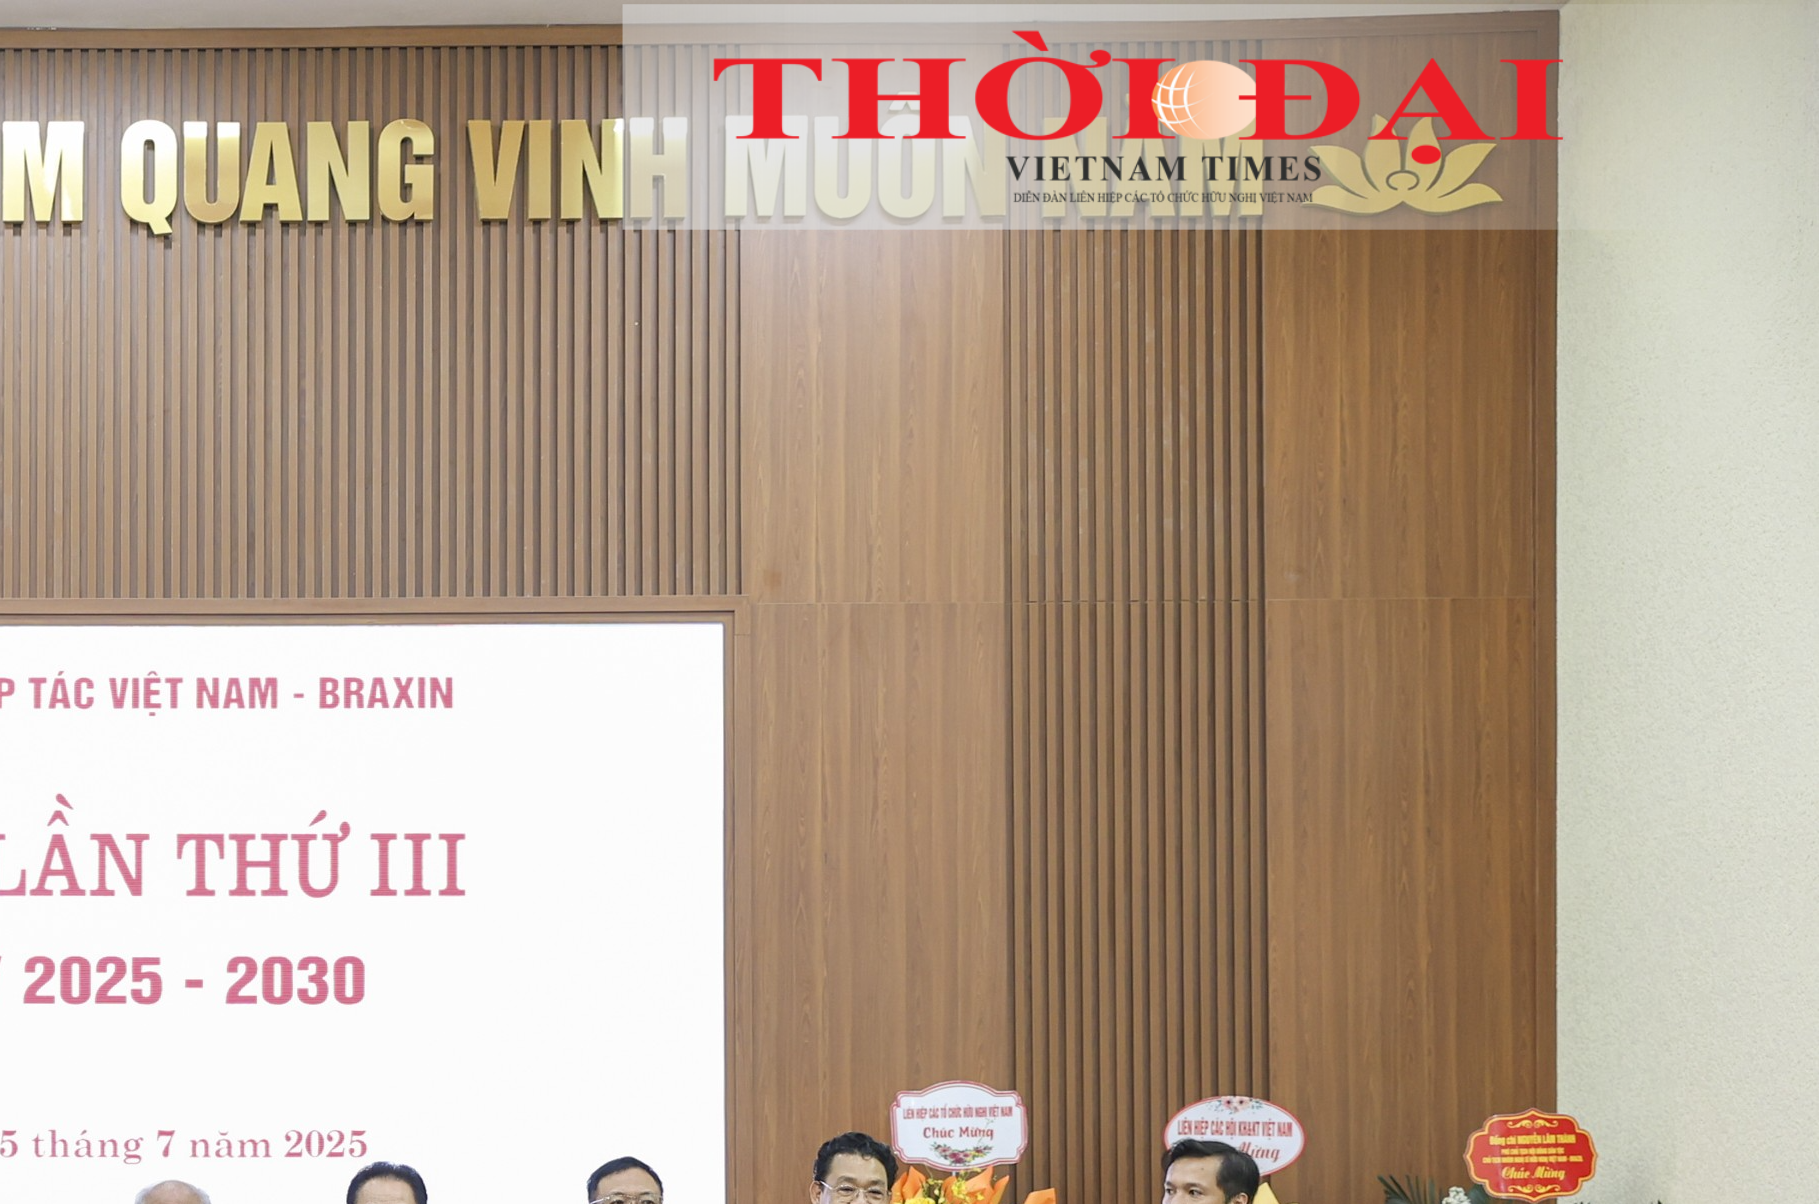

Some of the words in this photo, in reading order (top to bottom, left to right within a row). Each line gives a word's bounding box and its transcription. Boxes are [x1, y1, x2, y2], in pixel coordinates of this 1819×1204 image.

[120, 119, 435, 236] QUANG
[467, 117, 688, 222] VINH
[28, 671, 95, 710] TÁC
[108, 671, 184, 716] VIỆT
[196, 677, 279, 709] NAM
[318, 676, 454, 710] BRAXIN
[176, 810, 351, 898] THỨ
[370, 833, 466, 897] III
[24, 955, 163, 1005] 2025
[185, 979, 203, 988] -
[226, 955, 366, 1005] 2030
[32, 1129, 144, 1167] tháng
[157, 1129, 176, 1158] 7
[189, 1132, 272, 1158] năm
[284, 1129, 368, 1158] 2025
[923, 1126, 955, 1139] Chúc
[1501, 1166, 1530, 1180] Chúc
